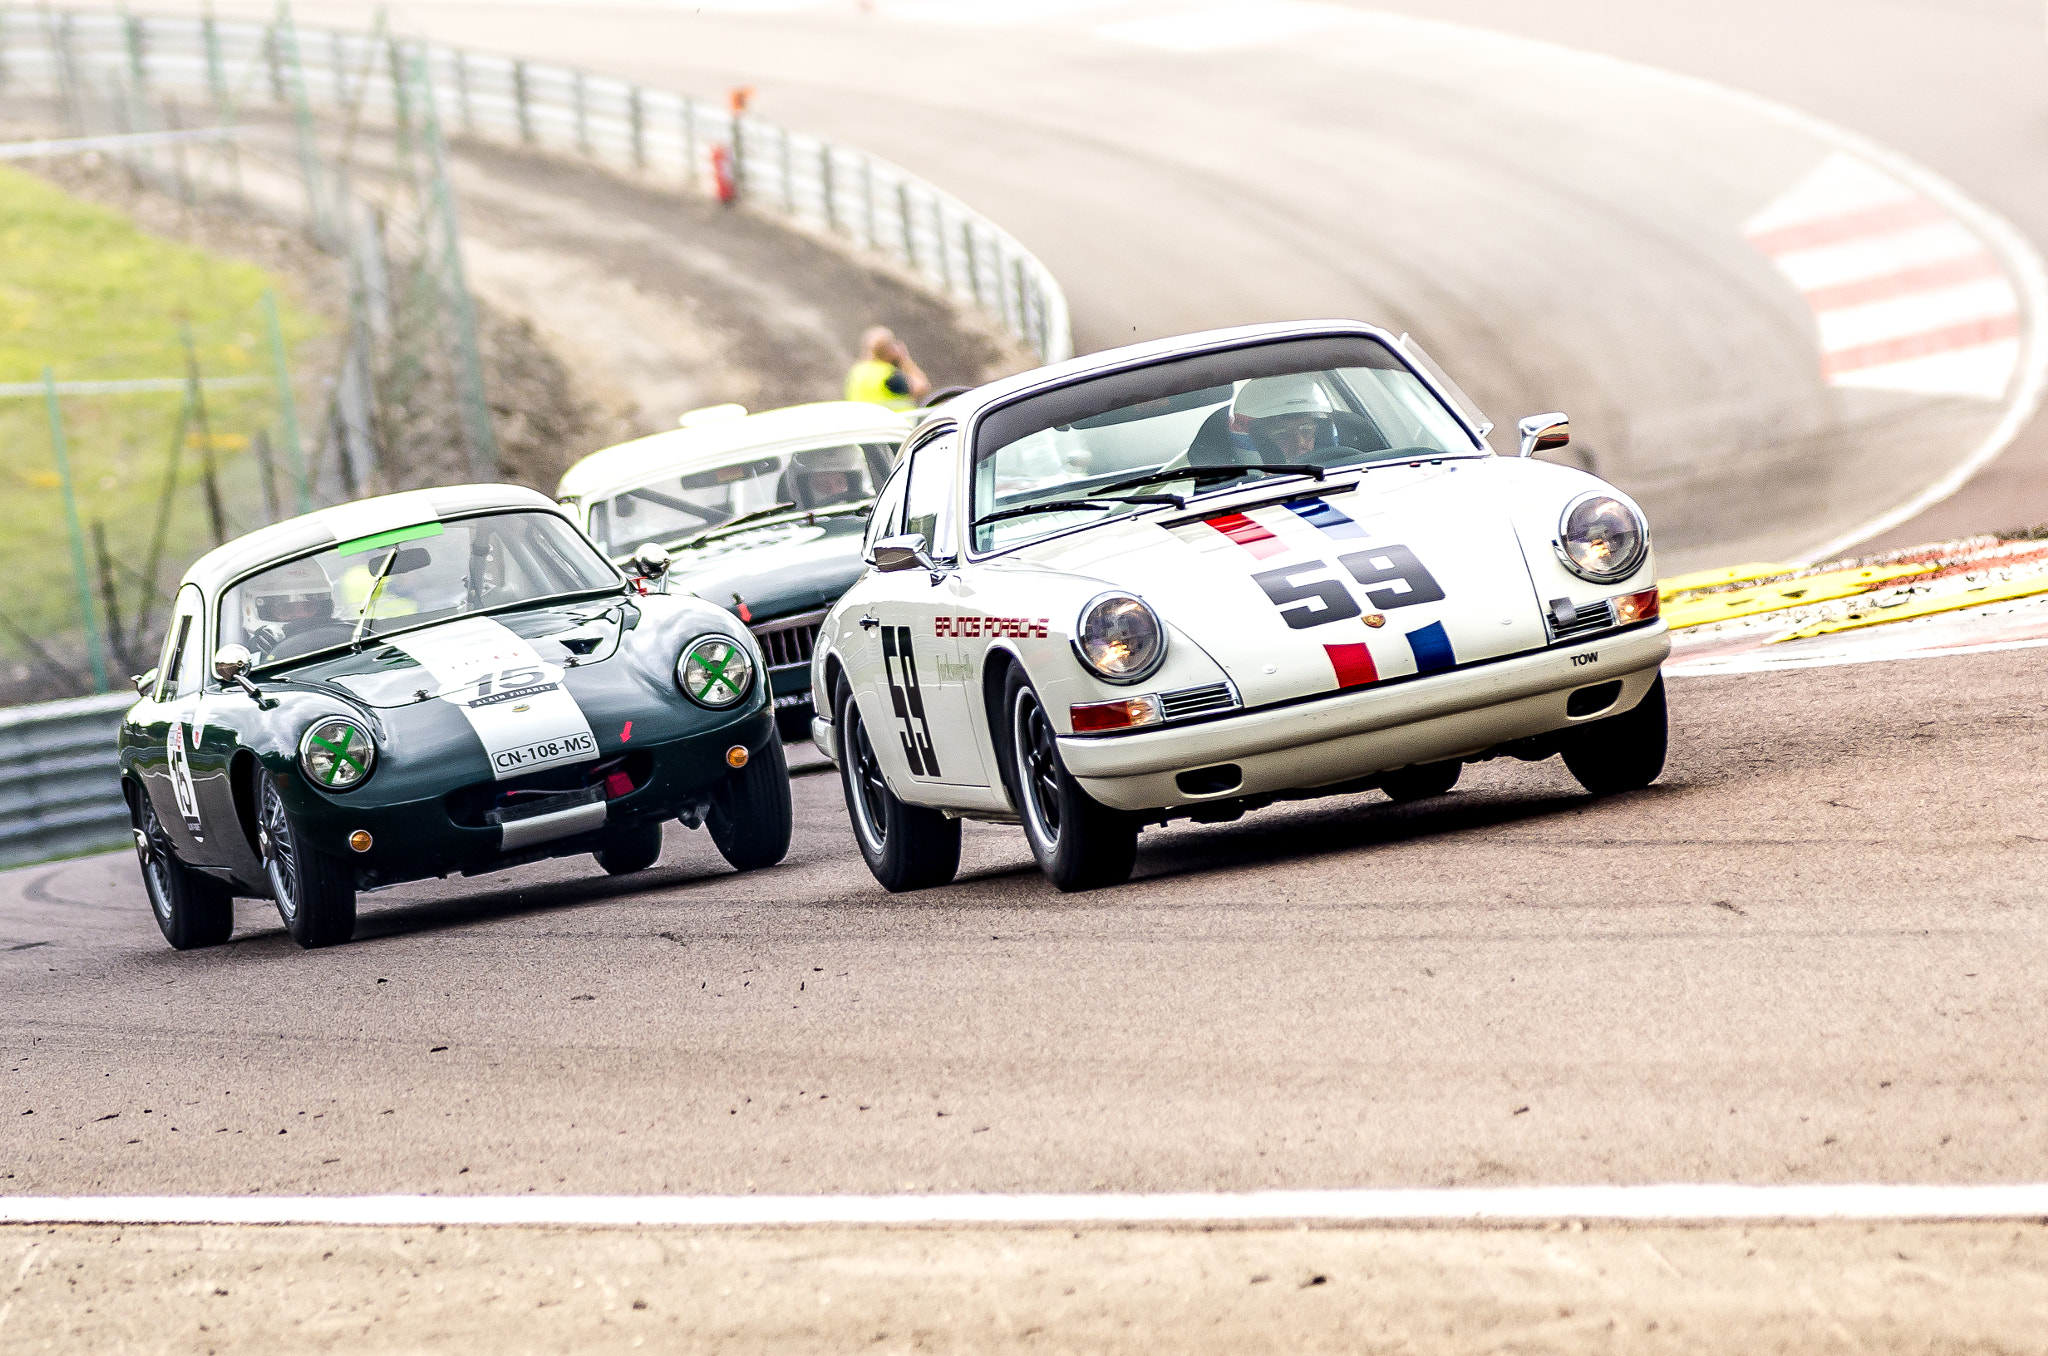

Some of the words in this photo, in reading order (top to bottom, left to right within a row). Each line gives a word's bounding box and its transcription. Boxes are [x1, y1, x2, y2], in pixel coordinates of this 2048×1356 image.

[1250, 544, 1446, 629] 59
[984, 617, 1050, 638] PORSCHE
[1570, 651, 1598, 666] TOW
[464, 665, 545, 696] 15
[476, 694, 506, 705] ALAIN
[880, 626, 941, 777] 59
[496, 735, 592, 767] CN-108-MS
[171, 750, 193, 815] 15
